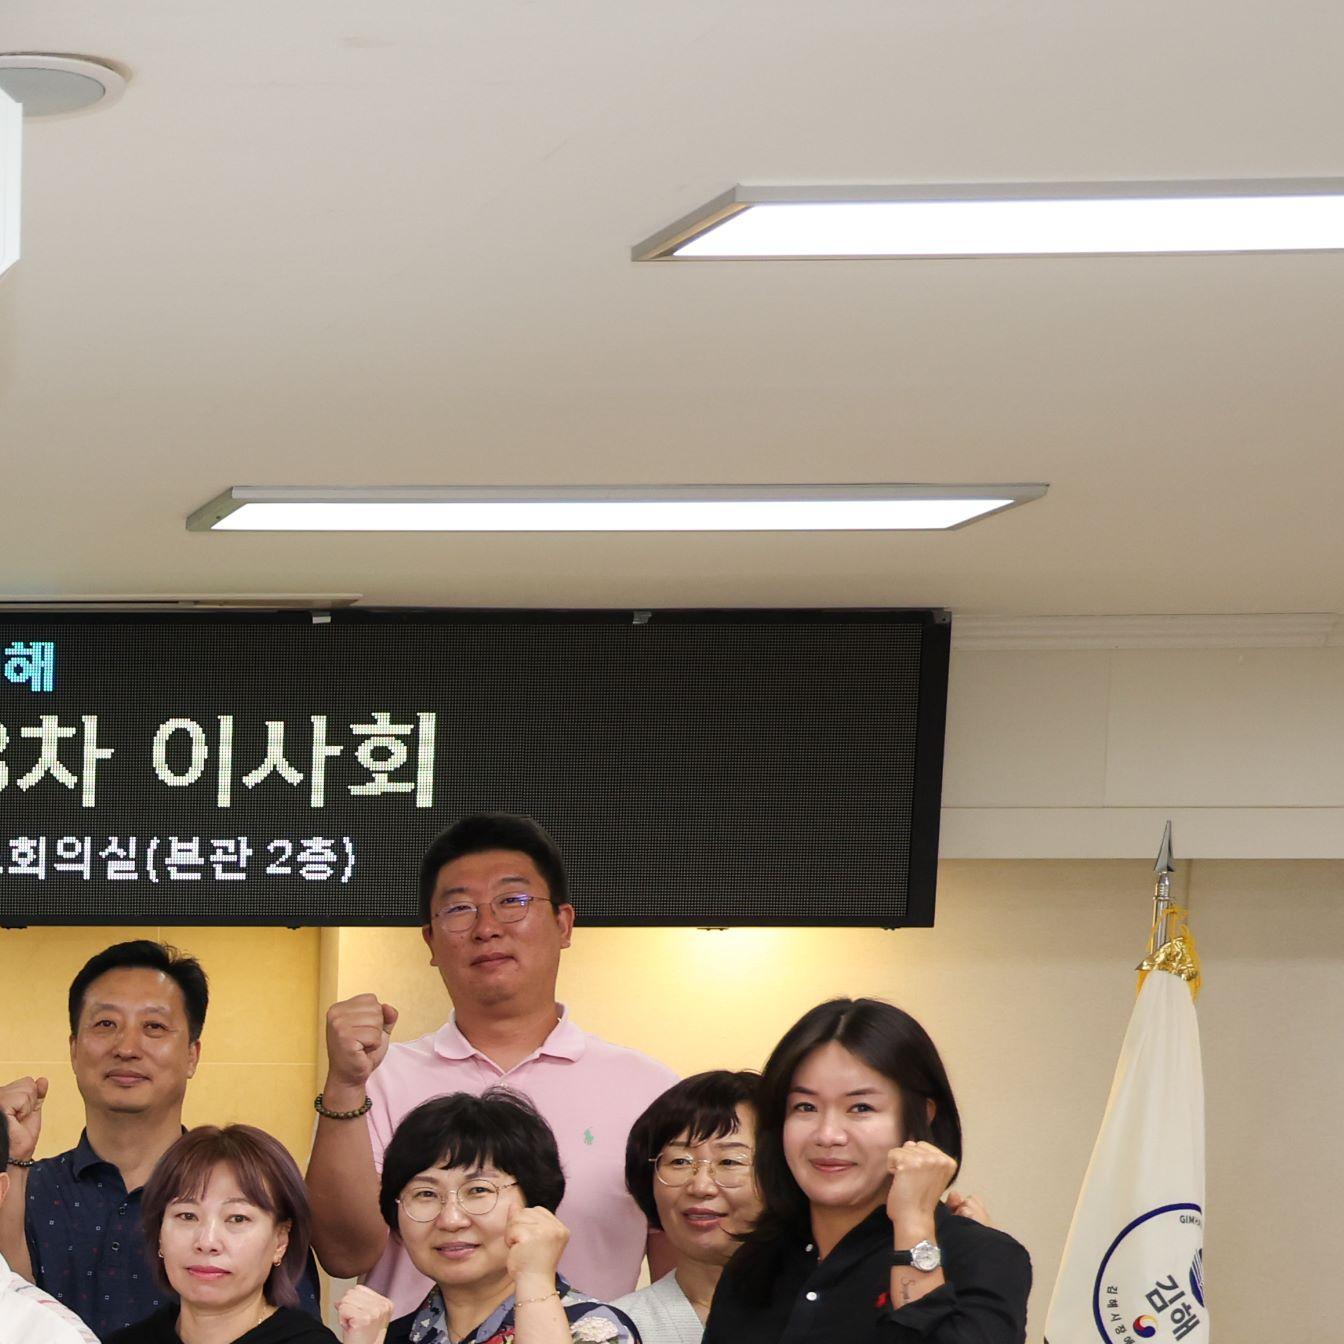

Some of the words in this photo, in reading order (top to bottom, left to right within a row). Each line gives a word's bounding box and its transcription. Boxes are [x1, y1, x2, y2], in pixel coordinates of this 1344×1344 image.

[152, 712, 436, 808] 이사회
[266, 836, 356, 884] 2층)
[1145, 1274, 1200, 1341] 김해
